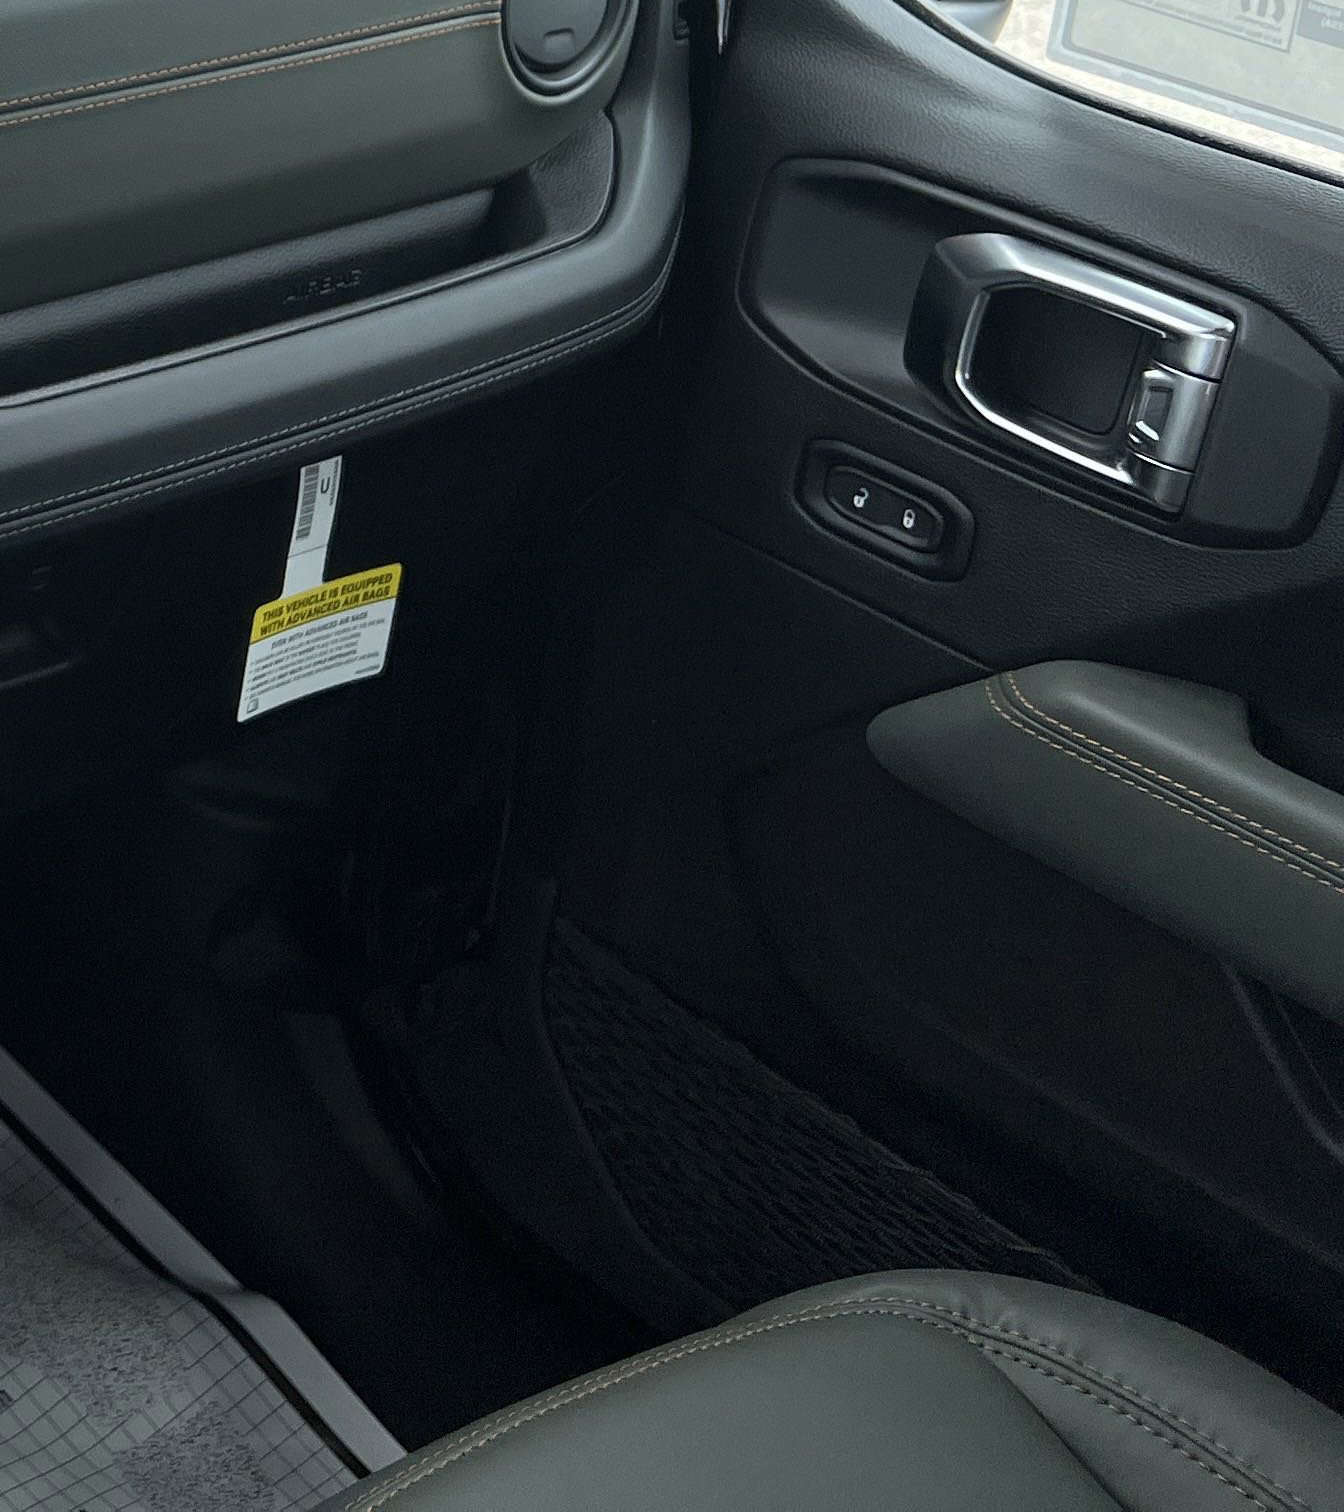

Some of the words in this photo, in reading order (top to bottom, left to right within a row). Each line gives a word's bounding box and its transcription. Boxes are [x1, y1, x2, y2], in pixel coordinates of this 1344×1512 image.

[320, 476, 330, 494] U
[260, 620, 284, 636] WITH
[286, 599, 341, 623] ADVANCED
[342, 593, 360, 607] AIR
[361, 585, 391, 602] BAGS
[262, 605, 283, 622] THIS
[286, 591, 328, 614] VEHICLE
[328, 586, 339, 599] IS
[340, 572, 393, 597] EQUIPPED
